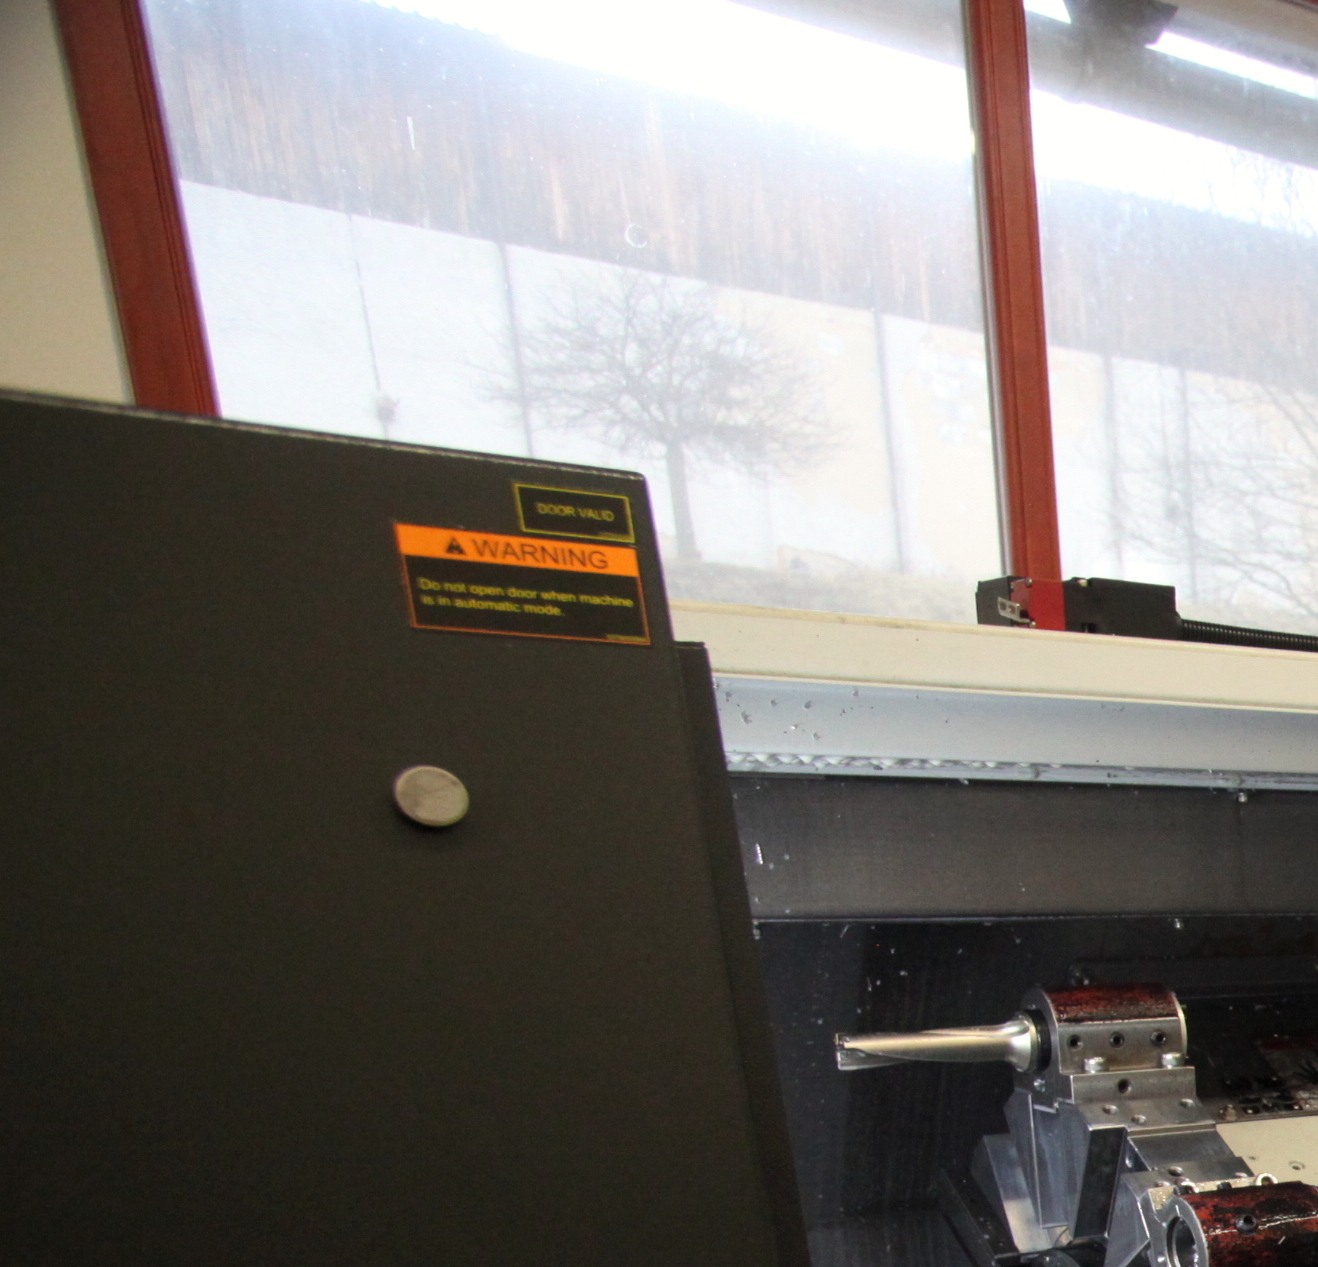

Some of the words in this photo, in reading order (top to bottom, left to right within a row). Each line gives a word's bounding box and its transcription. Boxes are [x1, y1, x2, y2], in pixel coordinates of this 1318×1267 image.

[536, 502, 576, 517] DOOR
[578, 506, 615, 522] VALID
[472, 538, 610, 570] WARNING
[418, 577, 440, 590] Do
[444, 581, 466, 594] not
[470, 585, 504, 598] open
[507, 586, 538, 600] door
[540, 590, 576, 602] when
[579, 592, 634, 608] machine
[420, 594, 435, 606] is
[438, 595, 452, 607] in
[454, 597, 522, 613] automatic
[522, 602, 566, 616] mode.
